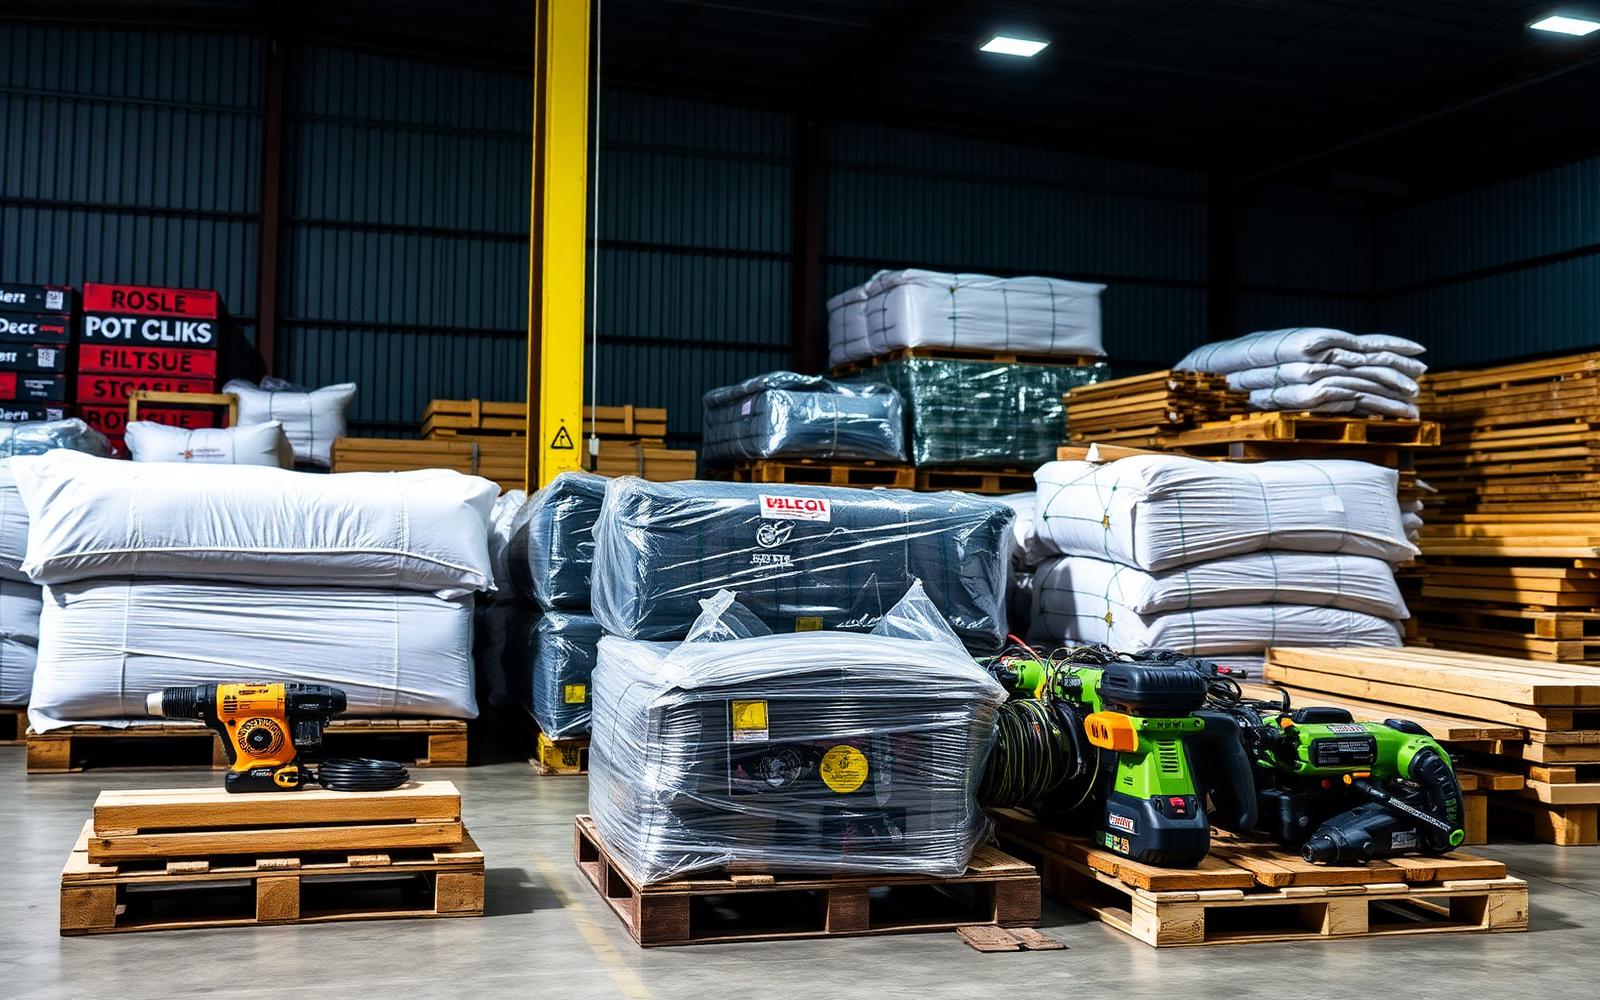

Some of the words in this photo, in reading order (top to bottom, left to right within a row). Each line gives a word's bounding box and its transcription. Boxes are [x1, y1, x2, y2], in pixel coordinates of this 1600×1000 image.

[111, 290, 187, 313] ROSLE
[85, 316, 136, 338] POT
[142, 321, 212, 343] CLIKS
[100, 349, 193, 372] FILTSUE
